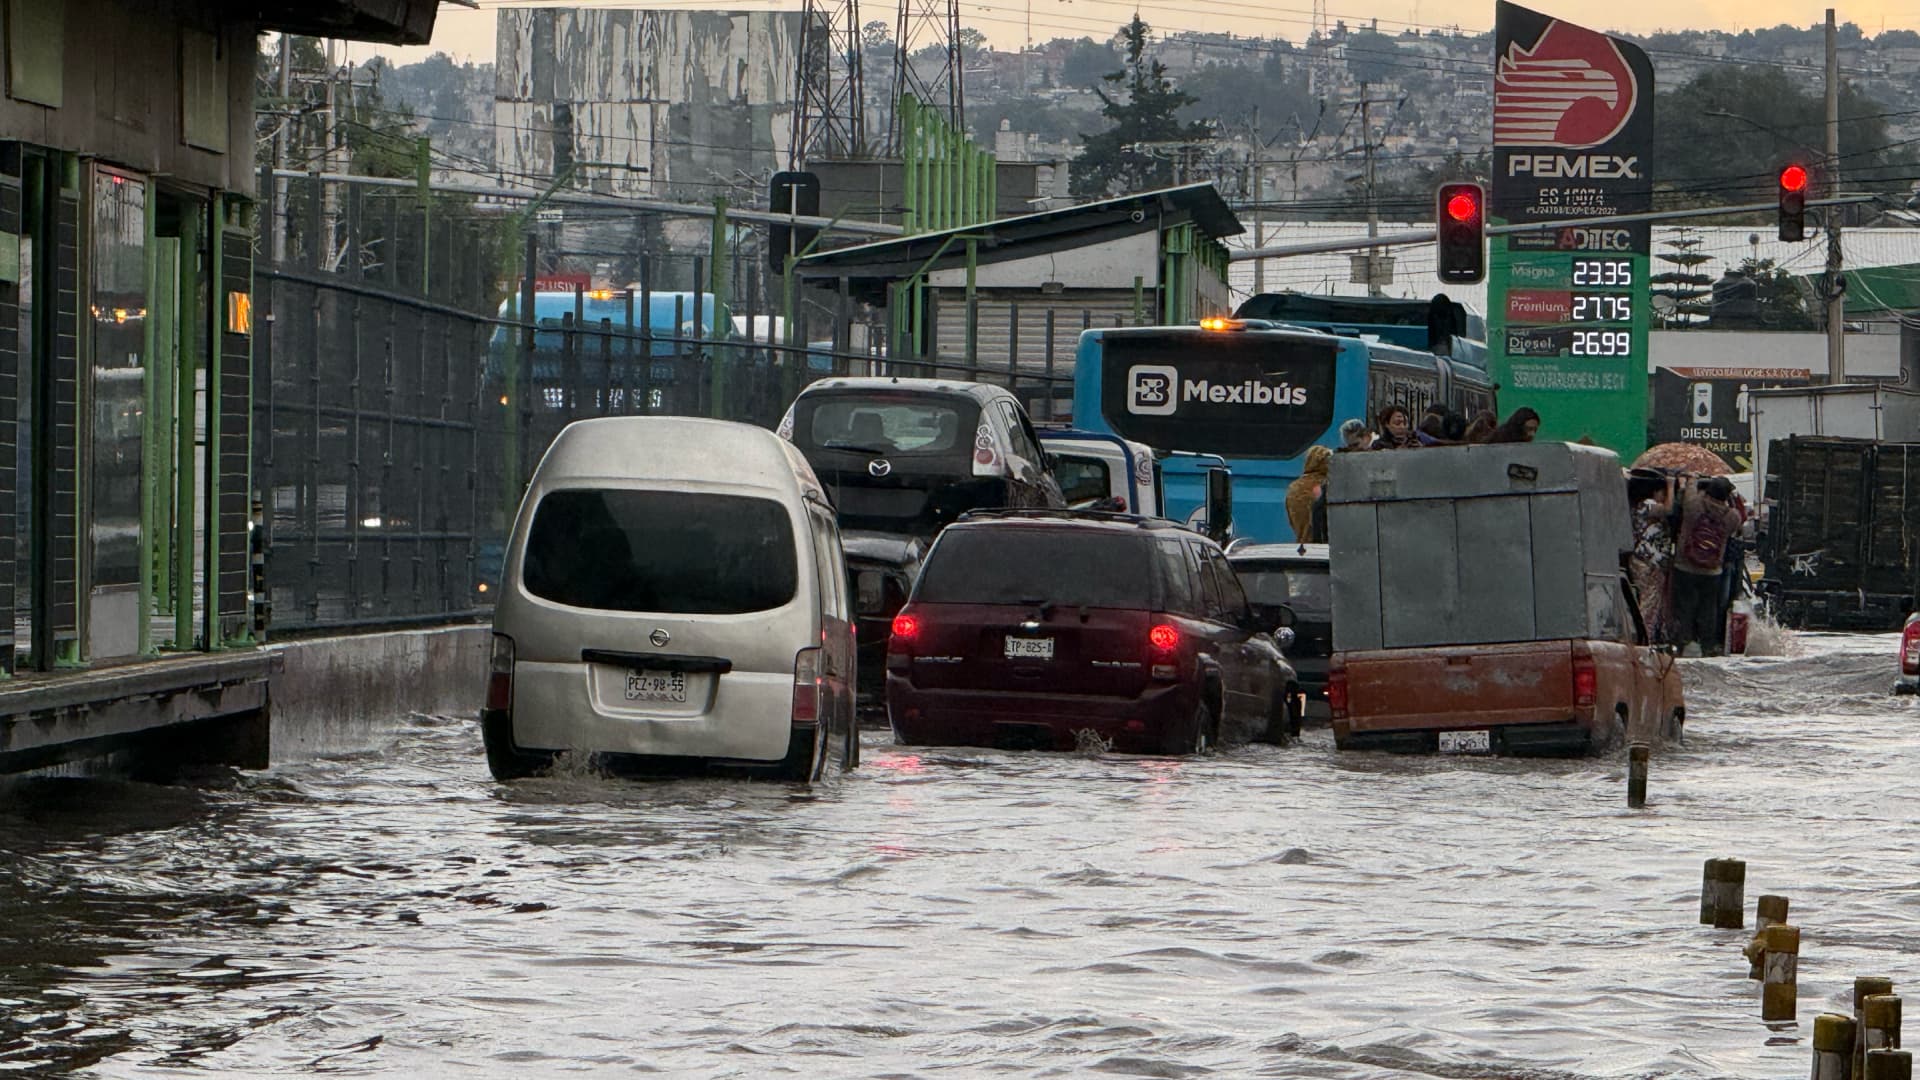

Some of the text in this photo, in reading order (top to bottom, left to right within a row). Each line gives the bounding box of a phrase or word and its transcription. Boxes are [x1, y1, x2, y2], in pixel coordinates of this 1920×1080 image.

[1508, 154, 1638, 179] PEMEX
[1539, 188, 1559, 205] ES
[1573, 261, 1632, 285] 23.35
[1510, 301, 1564, 313] Premium
[1572, 296, 1631, 320] 27.75
[1571, 331, 1631, 356] 26.99
[1183, 380, 1307, 405] Mexibús
[1680, 428, 1728, 440] DIESEL
